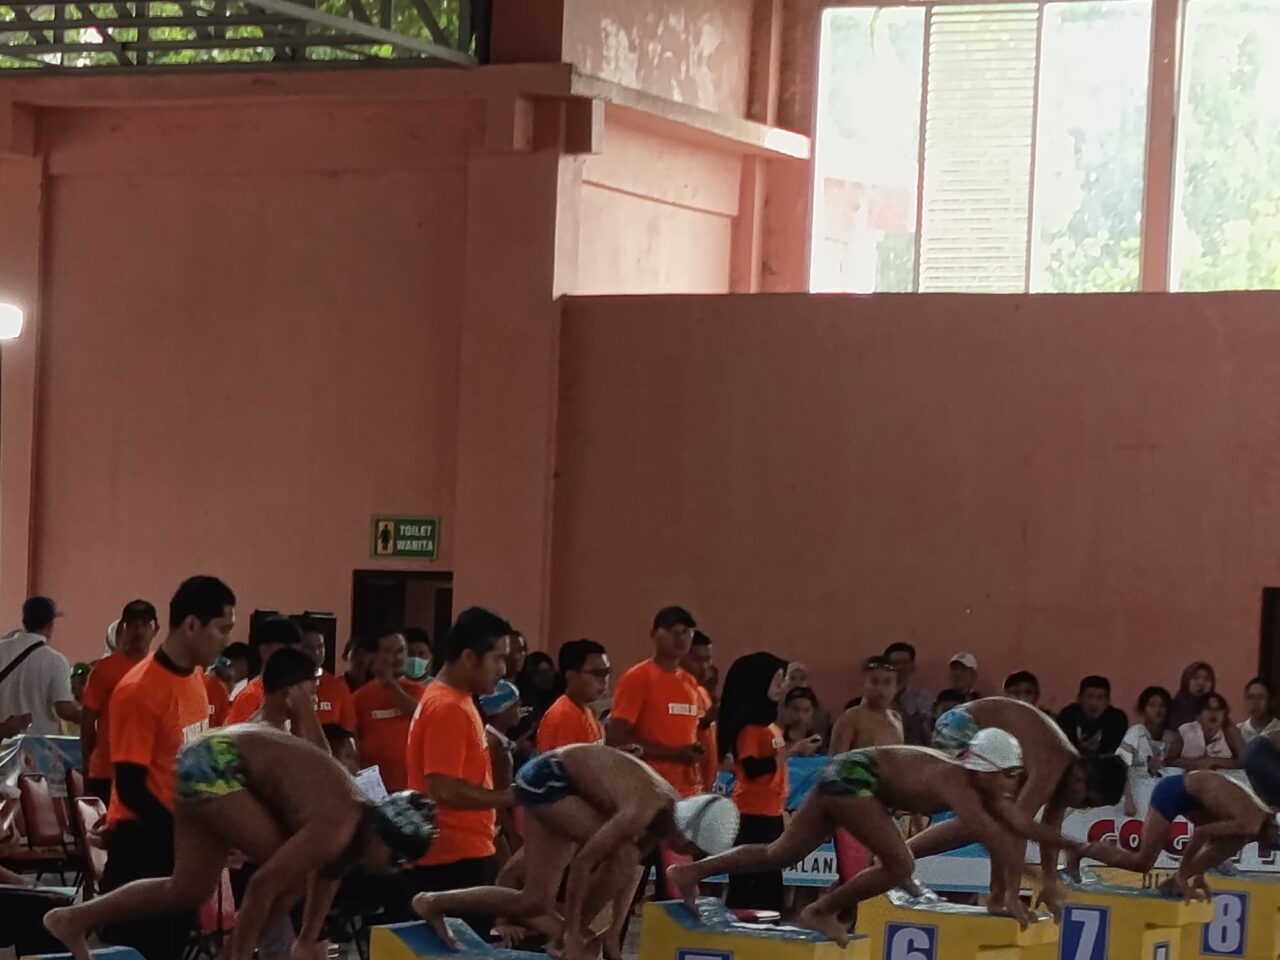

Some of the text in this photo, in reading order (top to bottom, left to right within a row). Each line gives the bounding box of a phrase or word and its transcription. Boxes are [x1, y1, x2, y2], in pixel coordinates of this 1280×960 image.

[399, 525, 433, 537] TOILET
[396, 540, 434, 551] WANITA
[1208, 894, 1242, 953] 8
